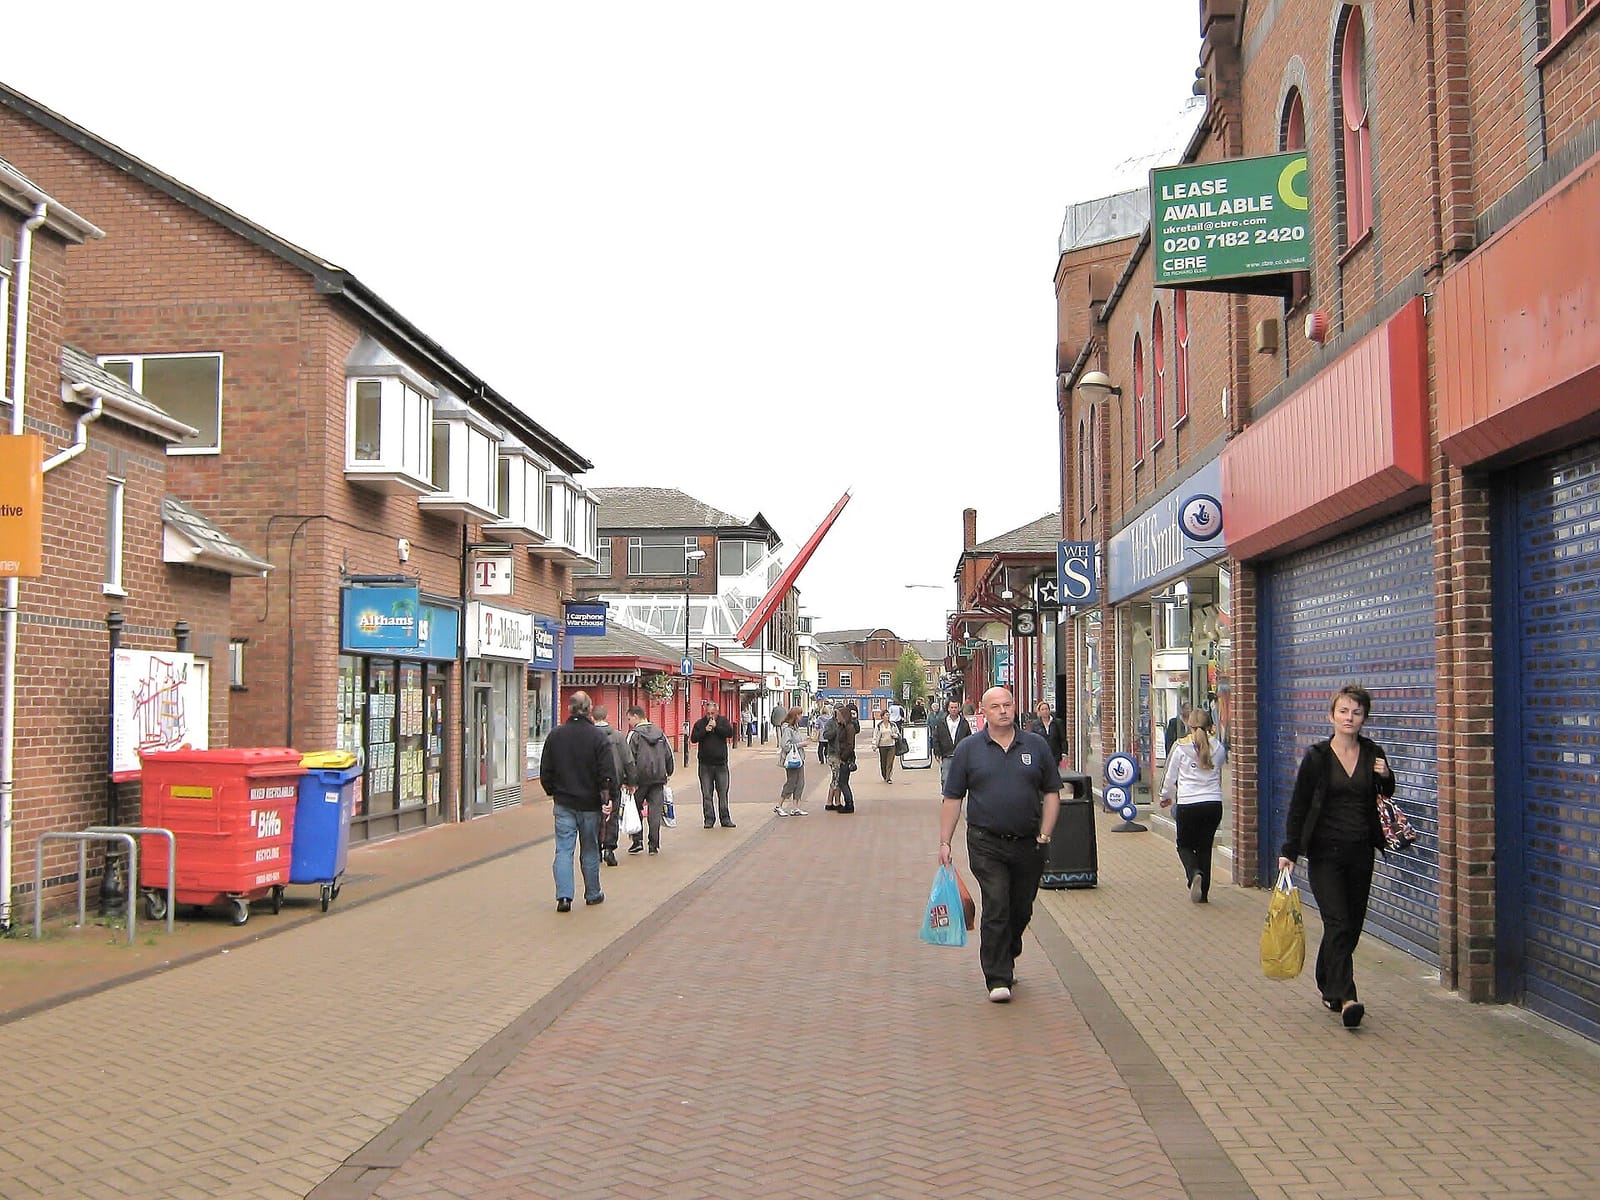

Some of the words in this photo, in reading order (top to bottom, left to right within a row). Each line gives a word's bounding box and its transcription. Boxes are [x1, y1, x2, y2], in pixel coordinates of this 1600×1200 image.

[1162, 179, 1228, 201] LEASE
[1163, 195, 1274, 221] AVAILABLE
[1163, 217, 1267, 234] ukretail@cbre.com
[1163, 236, 1200, 253] 020
[1205, 231, 1249, 249] 7182
[1254, 226, 1305, 245] 2420
[1163, 255, 1207, 271] CBRE
[0, 504, 23, 517] tive
[1130, 496, 1184, 584] WHSmith
[1063, 545, 1089, 557] WH
[0, 560, 20, 572] ney
[476, 561, 497, 587] T
[1063, 558, 1092, 599] S
[359, 614, 414, 626] Althams
[570, 613, 604, 621] Carphone
[1017, 613, 1034, 634] 3
[257, 811, 281, 838] Biffa
